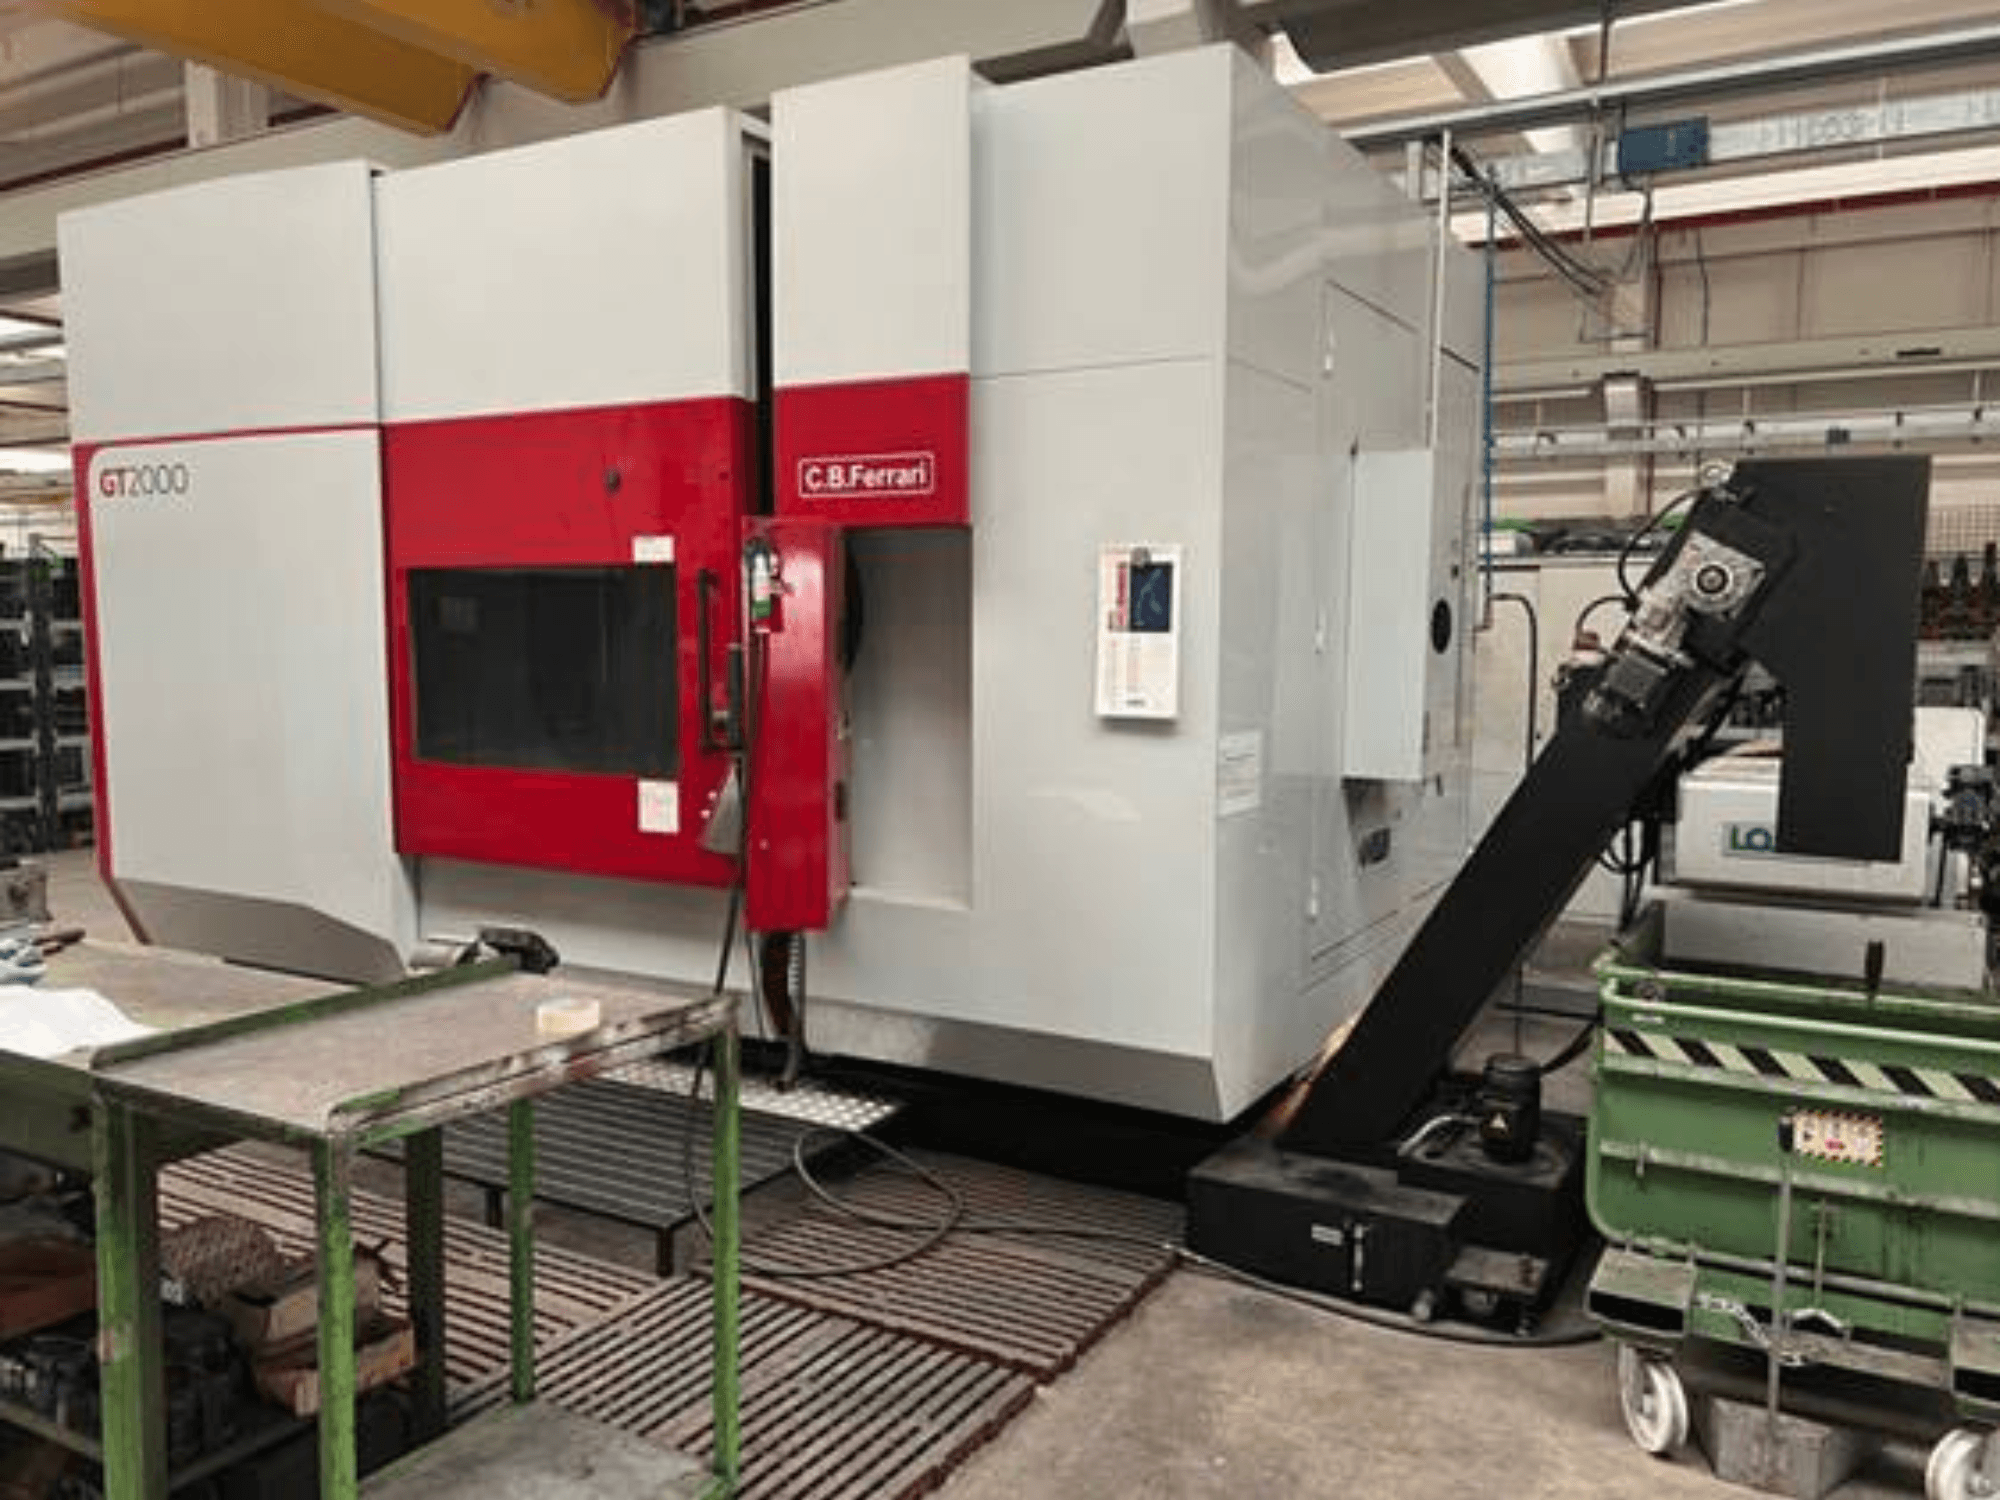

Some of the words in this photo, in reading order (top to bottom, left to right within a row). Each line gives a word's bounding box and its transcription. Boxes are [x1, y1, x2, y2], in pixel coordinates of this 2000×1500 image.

[99, 463, 189, 497] GT2000
[804, 460, 927, 491] C.B.Ferrari
[1731, 826, 1776, 853] LO
